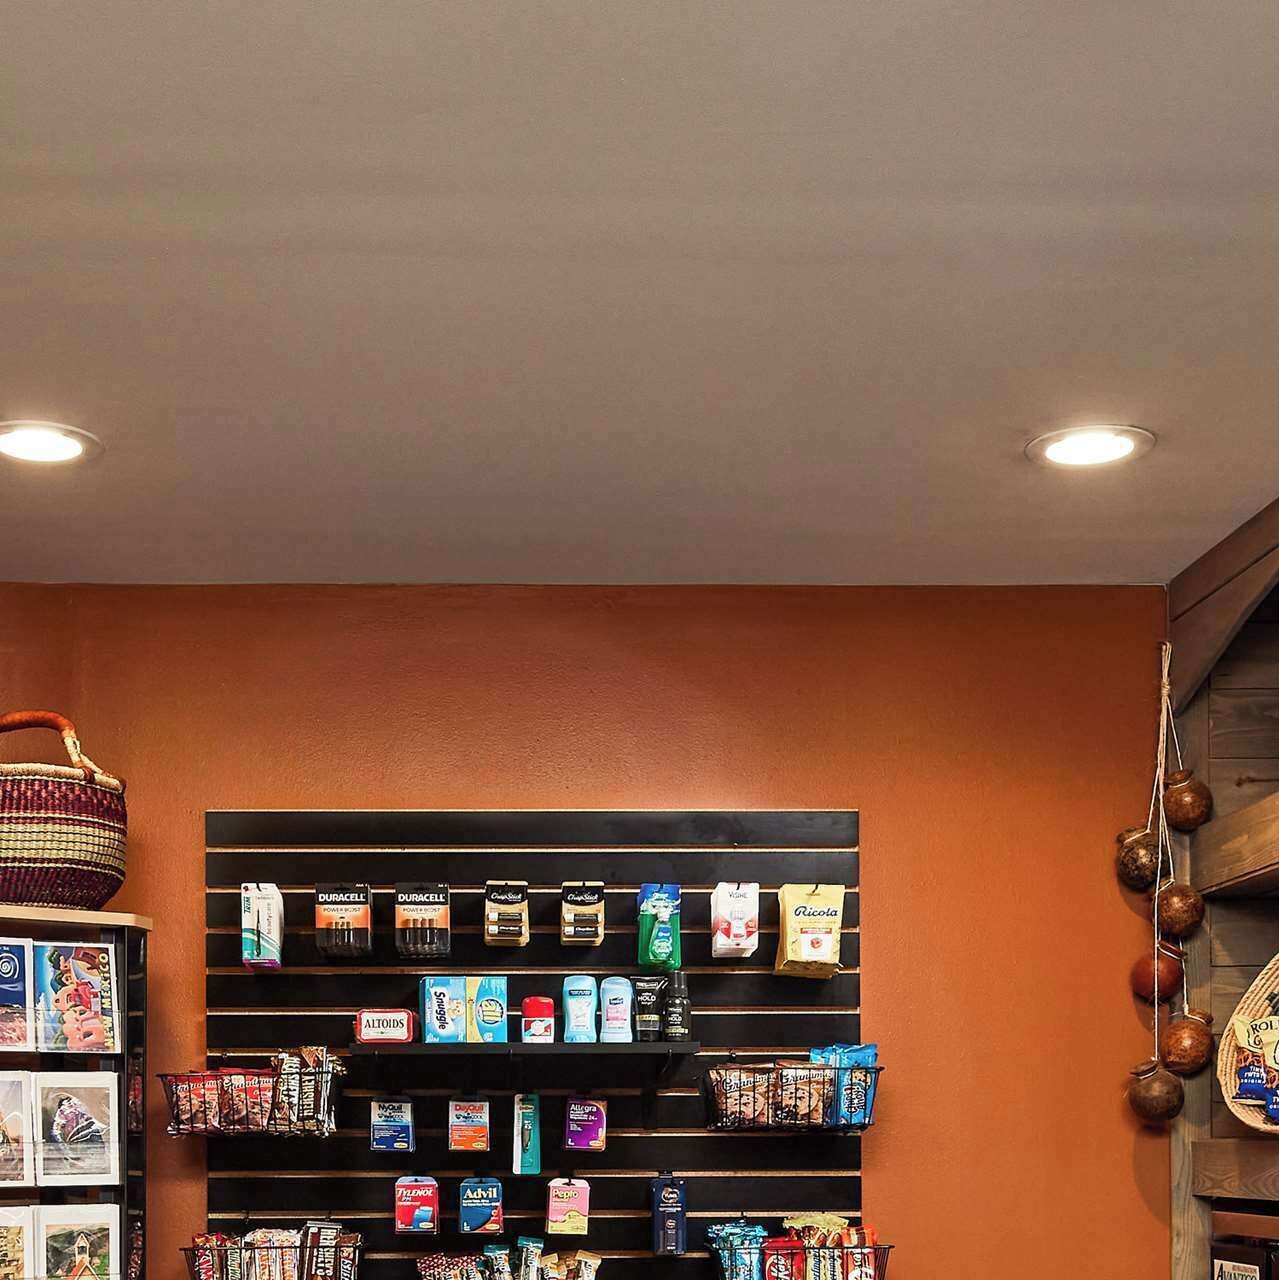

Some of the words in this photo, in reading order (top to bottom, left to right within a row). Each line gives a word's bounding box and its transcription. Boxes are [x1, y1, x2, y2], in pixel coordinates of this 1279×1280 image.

[319, 893, 365, 903] DURACELL
[398, 893, 445, 903] DURACELL
[490, 891, 523, 901] ChapStick
[567, 892, 599, 902] ChapStick
[322, 906, 343, 914] POWER
[402, 906, 423, 914] POWER
[793, 904, 839, 918] Ricola
[98, 952, 114, 1013] MEXICO
[433, 990, 450, 1031] Snuggle
[364, 1017, 405, 1030] ALTOIDS
[103, 1016, 116, 1049] NEW
[378, 1103, 403, 1113] NyQuil
[454, 1103, 484, 1112] DayQuil
[396, 1188, 433, 1198] TYLENOL
[463, 1187, 497, 1199] Advil
[552, 1189, 579, 1201] Pepto
